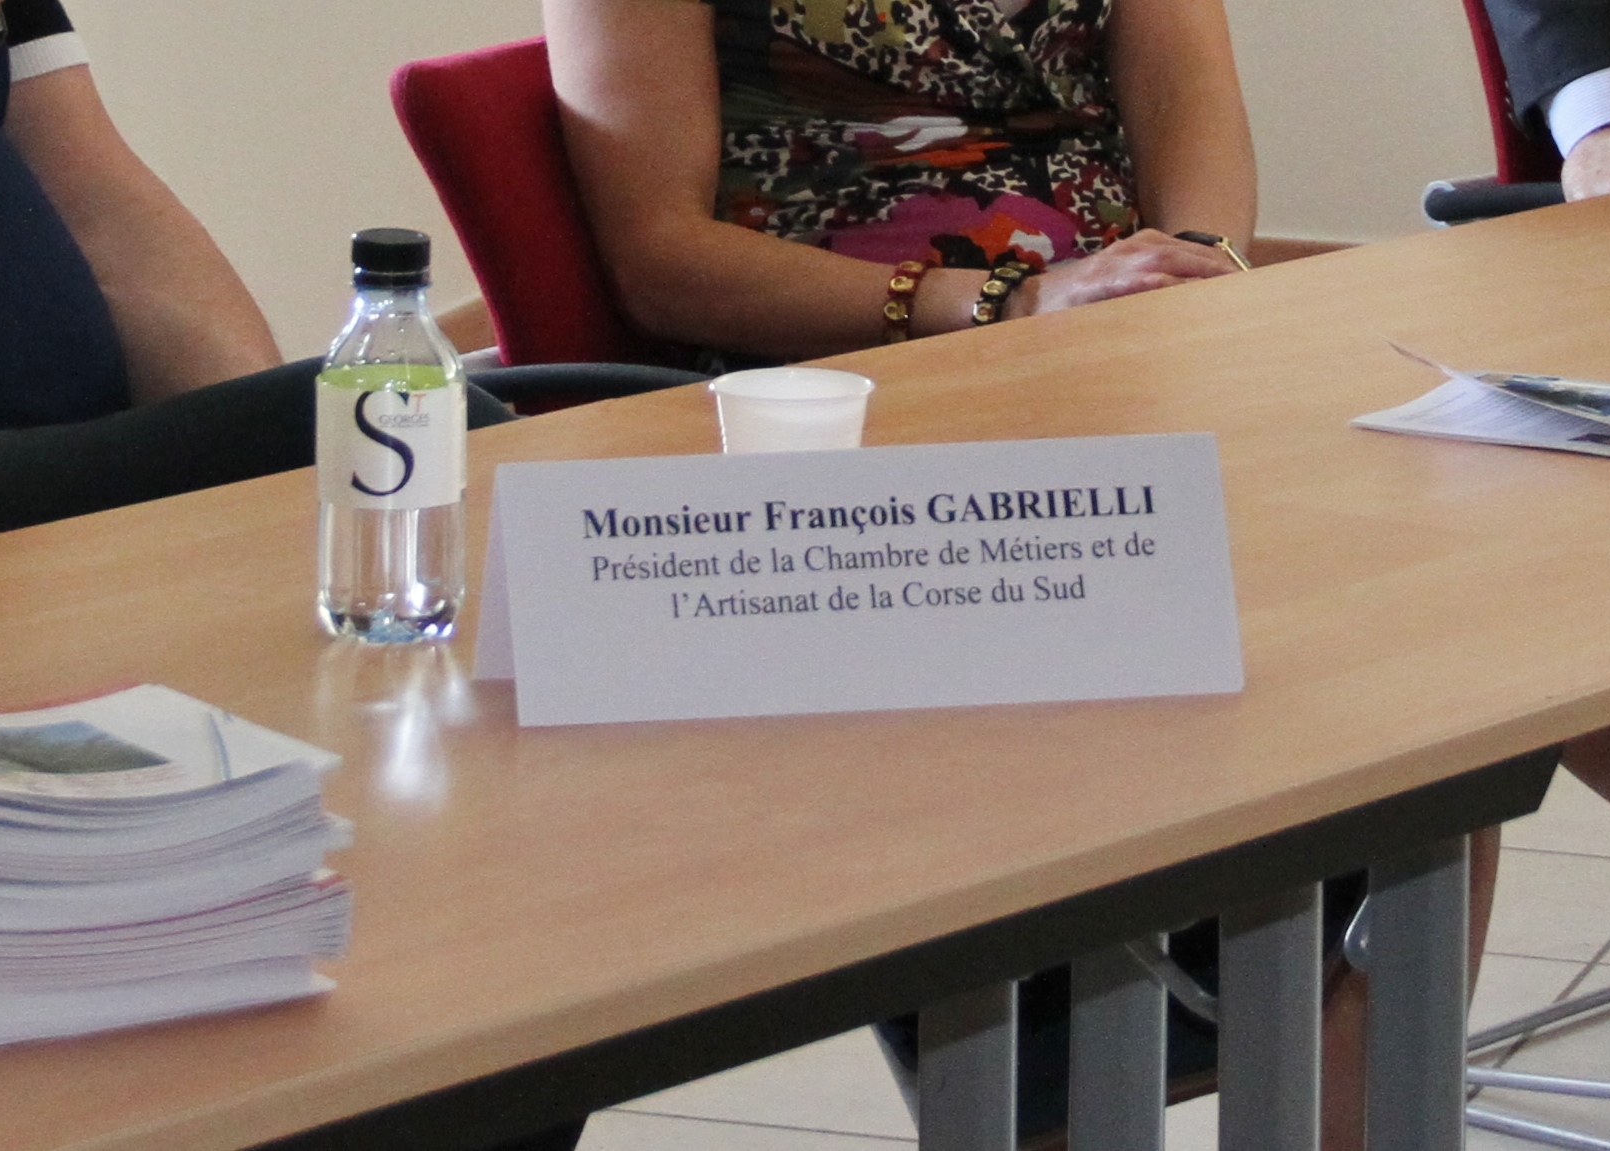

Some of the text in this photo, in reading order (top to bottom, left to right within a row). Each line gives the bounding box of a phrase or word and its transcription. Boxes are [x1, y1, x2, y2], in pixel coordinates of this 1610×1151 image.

[581, 484, 1156, 540] Monsieur François GABRIELLI
[592, 530, 1156, 582] Président de la Chambre de Métiers et de
[827, 584, 860, 613] de
[869, 583, 895, 610] la
[901, 581, 982, 608] Corse
[990, 577, 1026, 604] du
[1032, 573, 1087, 602] Sud
